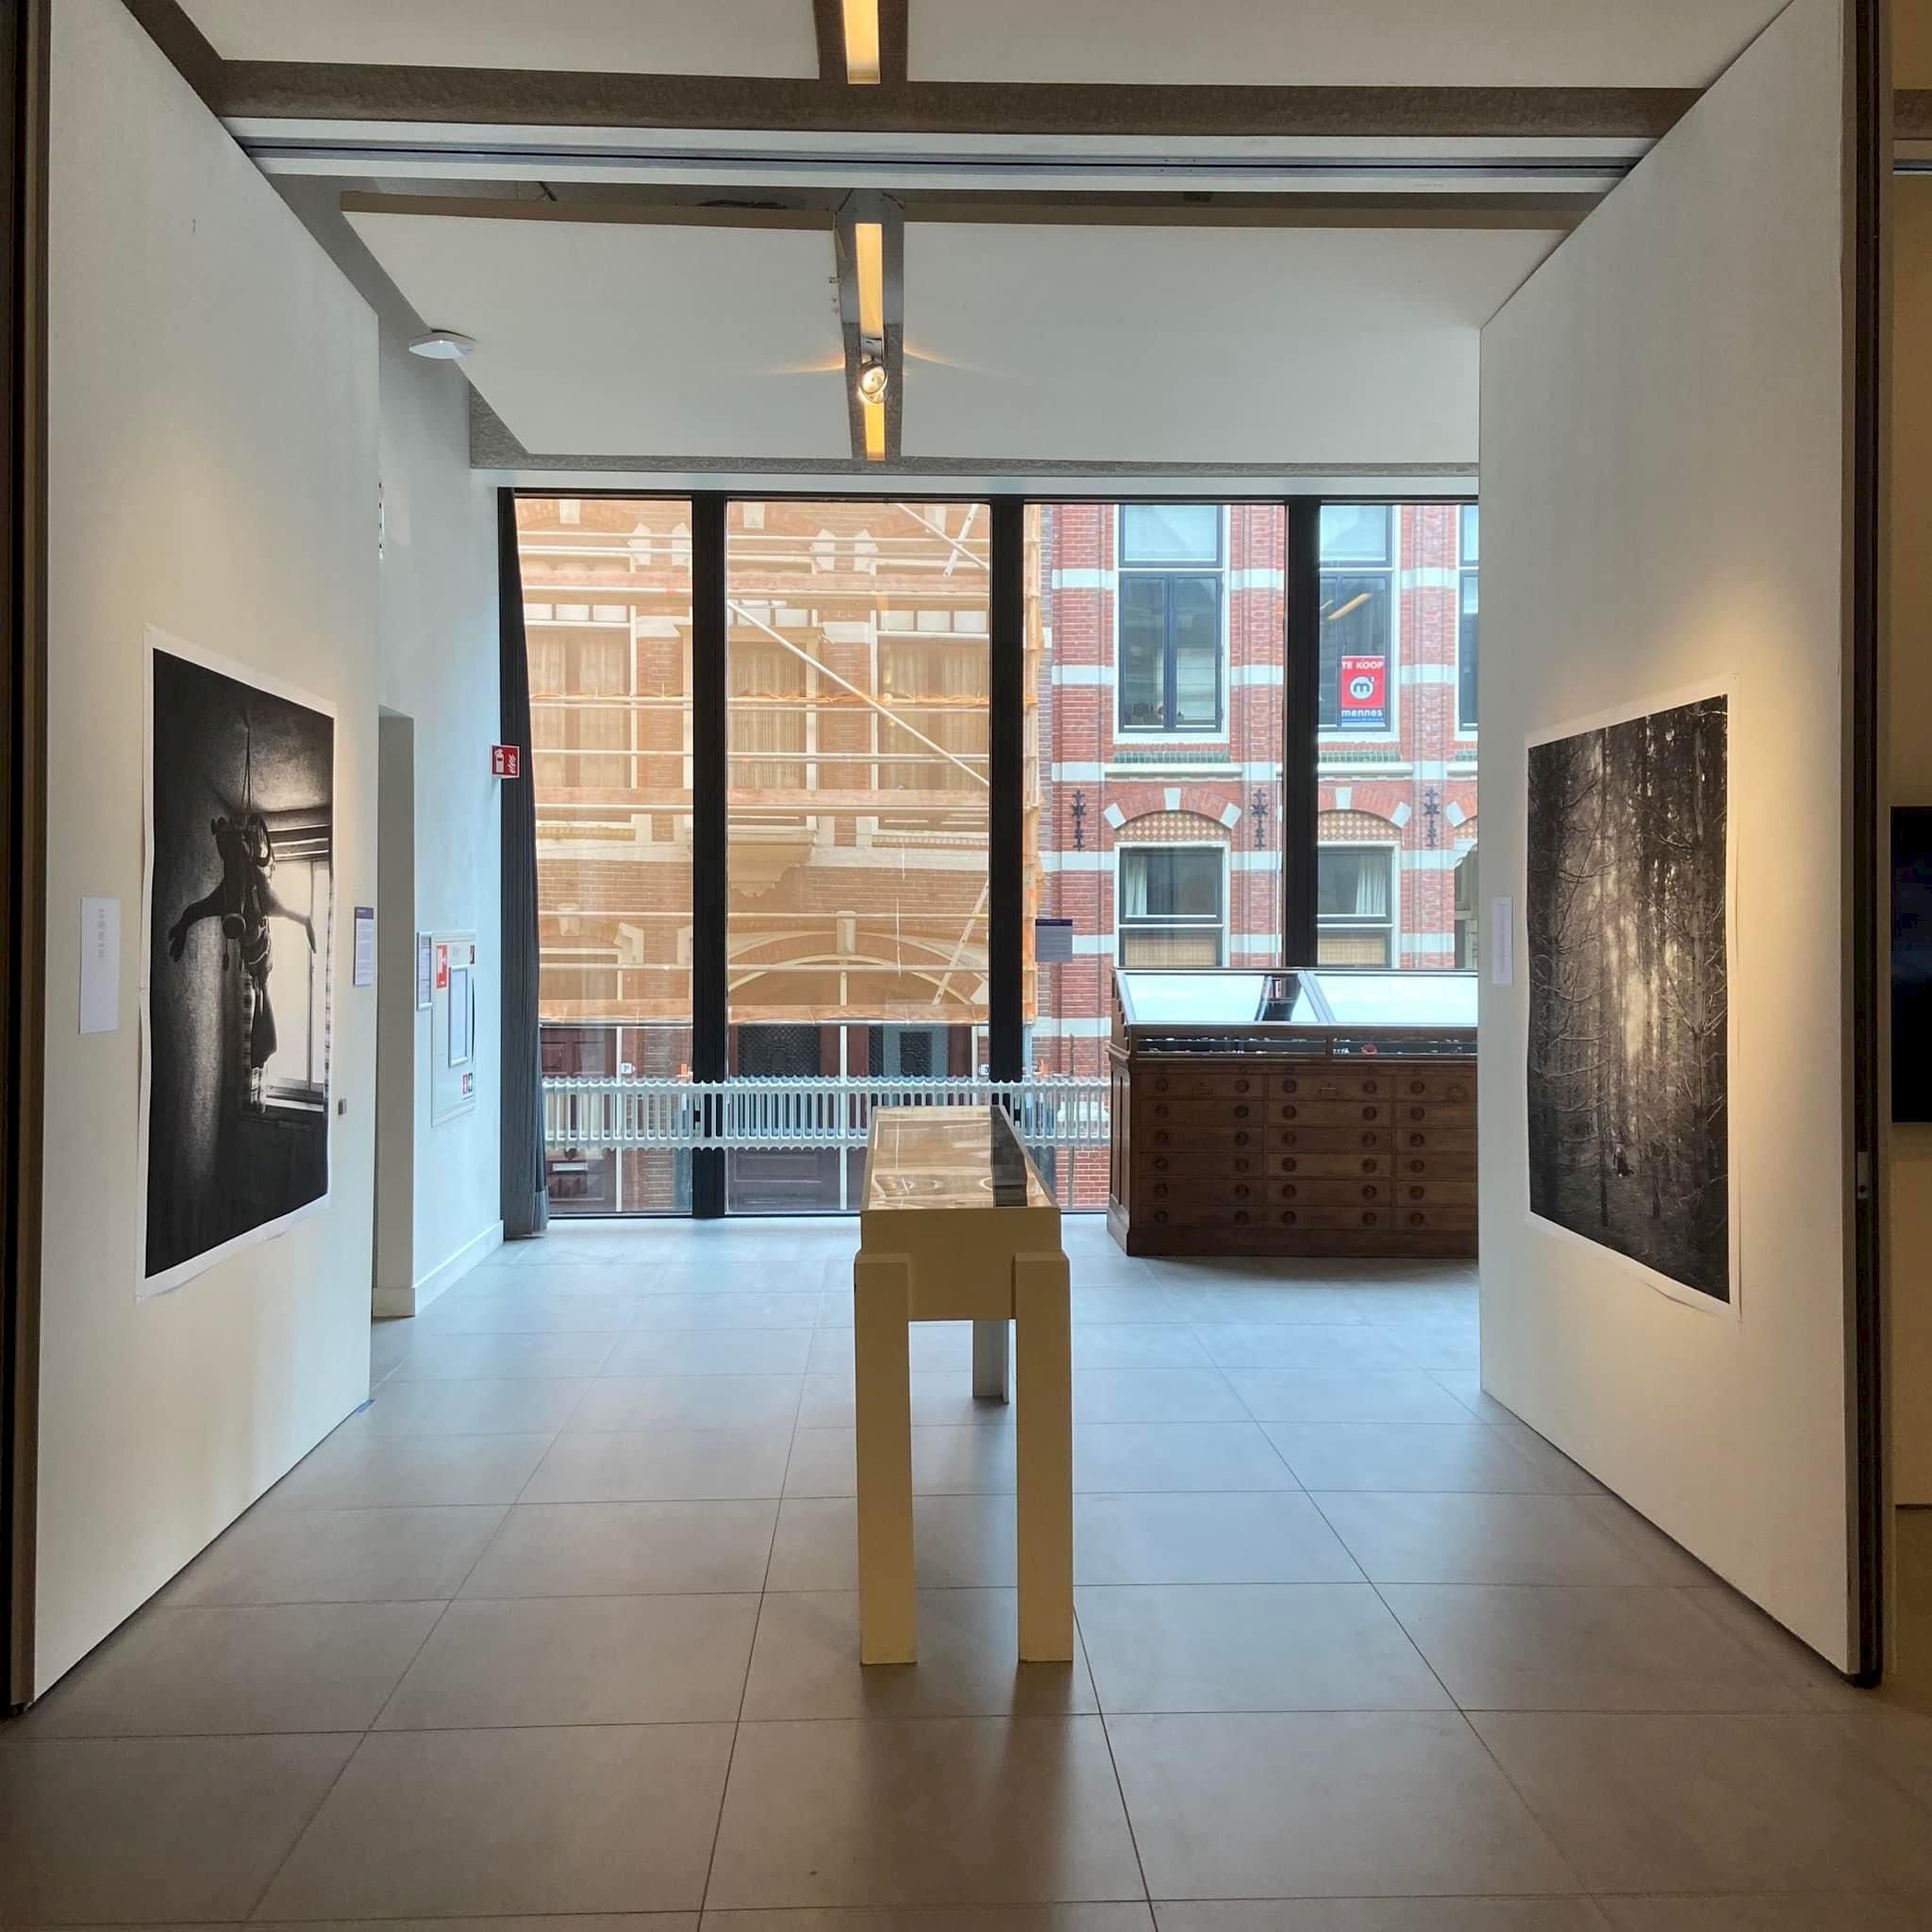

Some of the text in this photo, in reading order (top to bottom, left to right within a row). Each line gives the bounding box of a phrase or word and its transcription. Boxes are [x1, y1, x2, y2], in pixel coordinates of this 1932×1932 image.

[1341, 660, 1384, 670] TE KOOP
[1341, 708, 1383, 717] mennes
